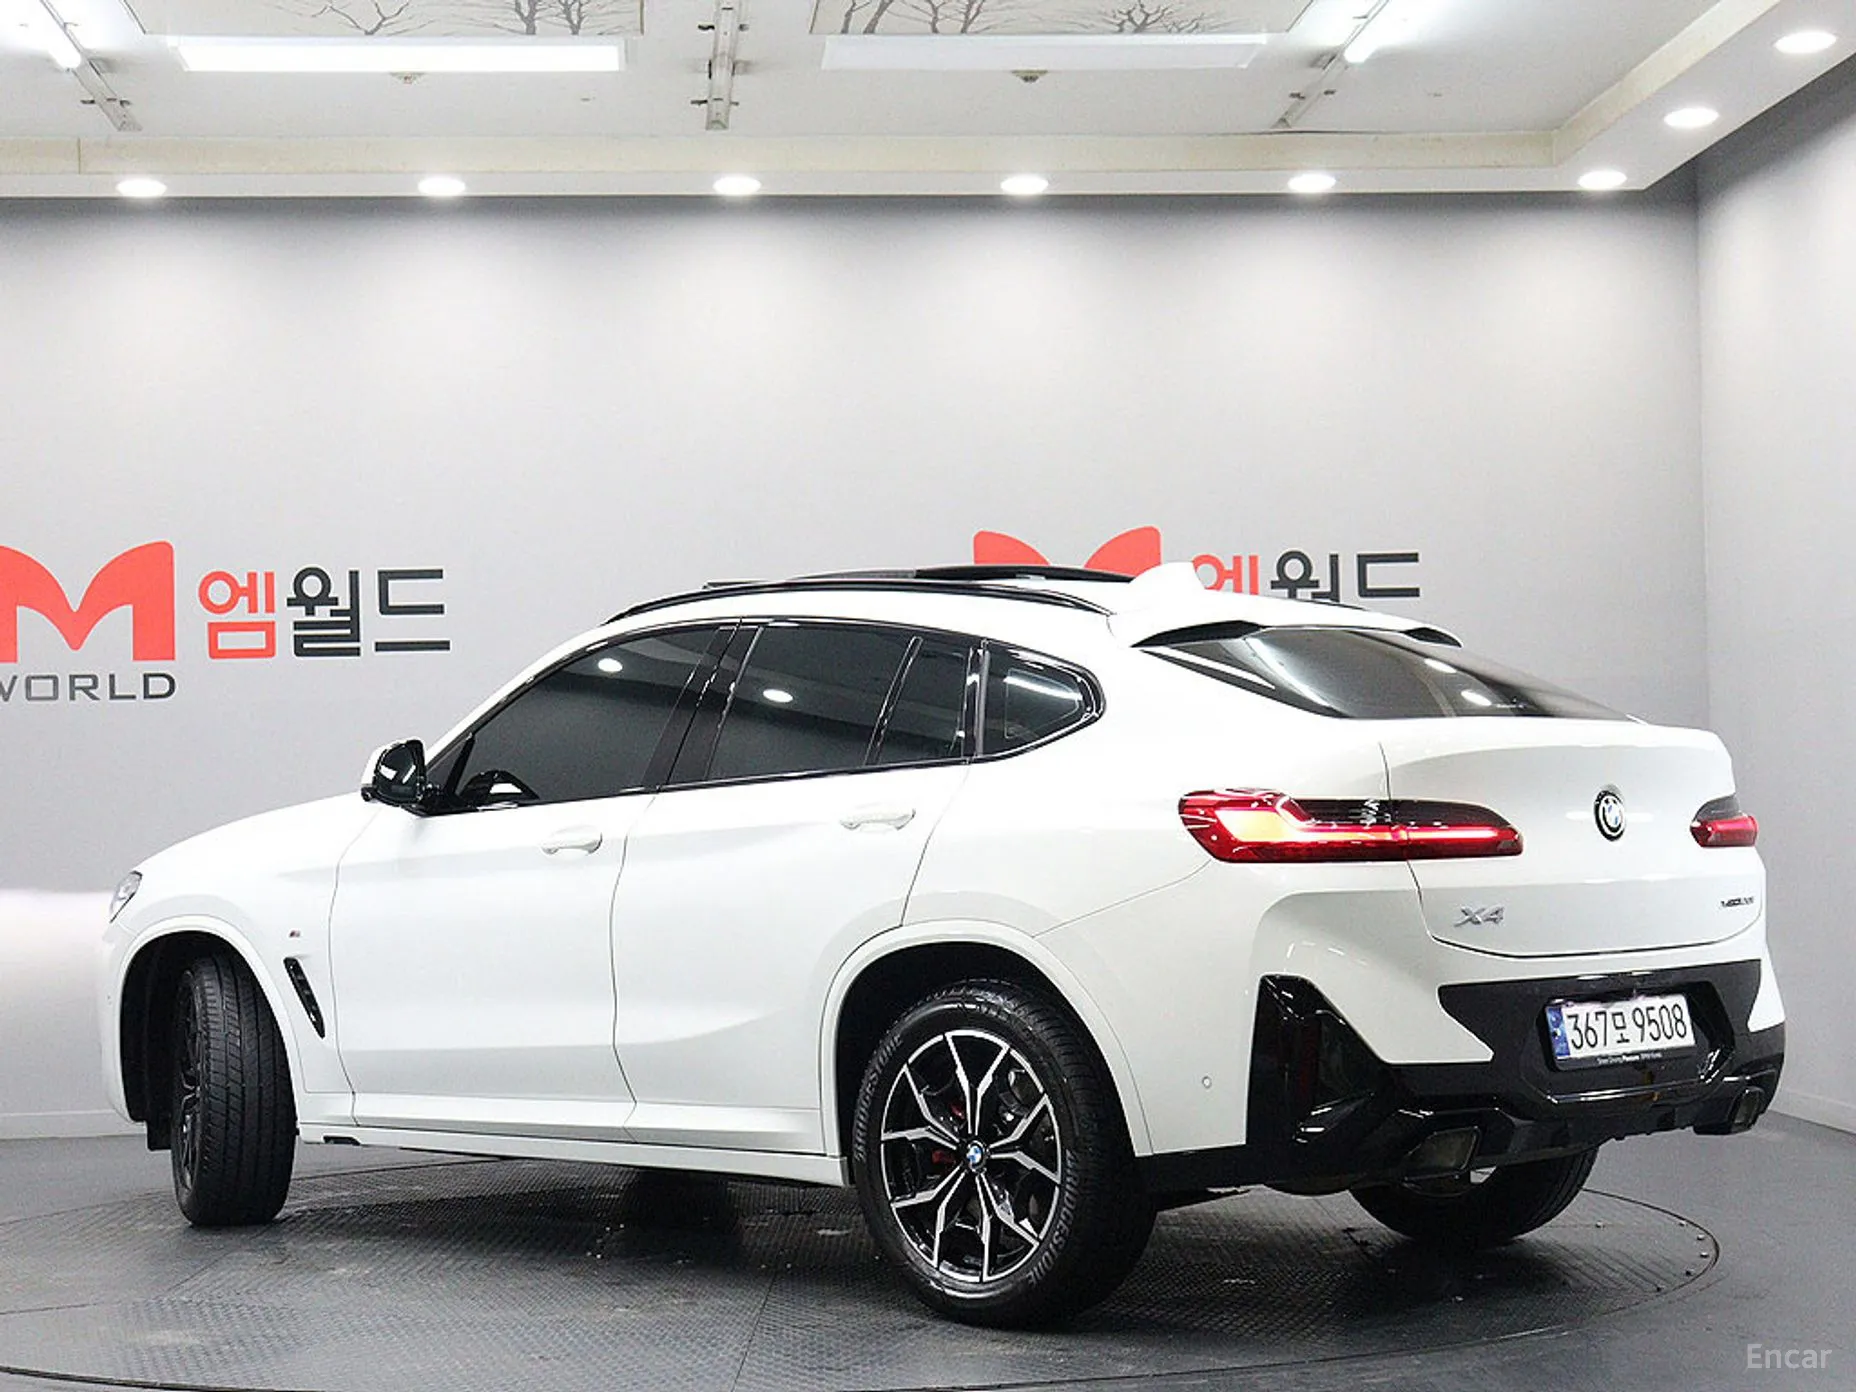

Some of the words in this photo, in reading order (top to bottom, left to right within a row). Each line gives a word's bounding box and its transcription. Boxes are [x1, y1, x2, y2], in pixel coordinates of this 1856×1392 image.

[199, 566, 451, 659] 엠월드
[1453, 905, 1505, 928] X4
[1027, 1148, 1081, 1288] BRIDGESTONE
